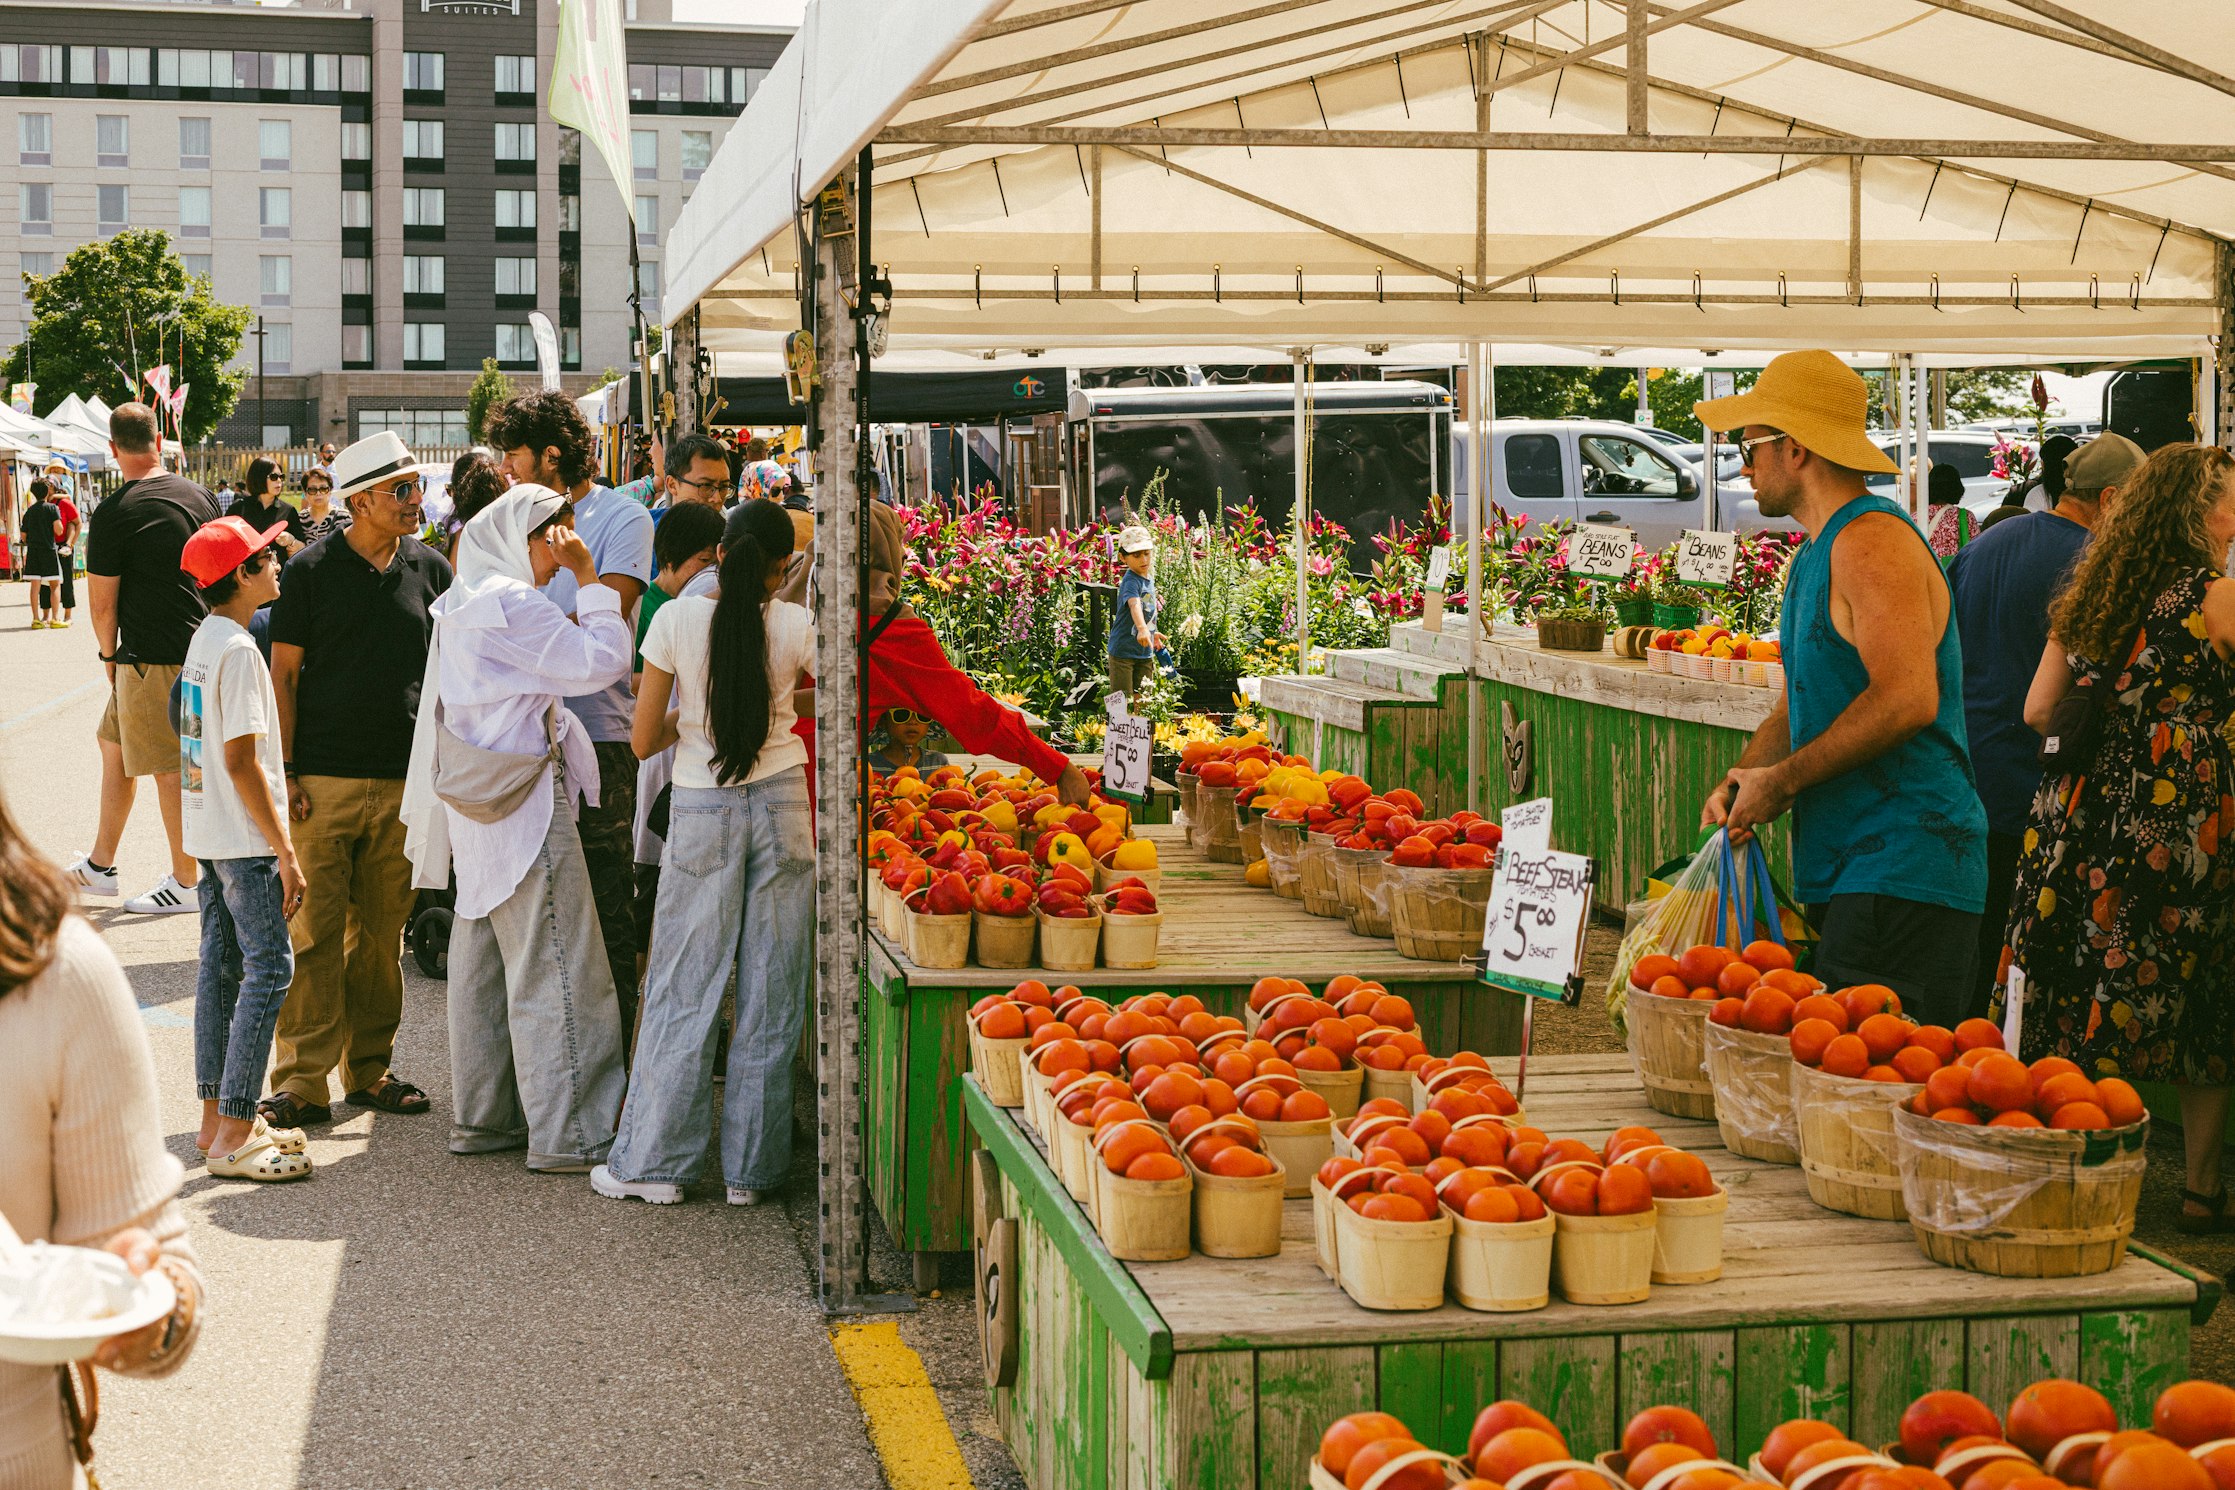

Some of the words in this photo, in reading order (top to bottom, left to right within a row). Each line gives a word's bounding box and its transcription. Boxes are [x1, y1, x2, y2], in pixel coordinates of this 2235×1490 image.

[444, 6, 498, 15] SUITES
[1013, 376, 1045, 396] OTC
[1579, 538, 1628, 559] BEANS
[1688, 536, 1727, 560] BEANS
[1110, 716, 1130, 738] SWEET
[1129, 718, 1149, 740] BELL
[1506, 851, 1586, 896] BEEFSTEAK
